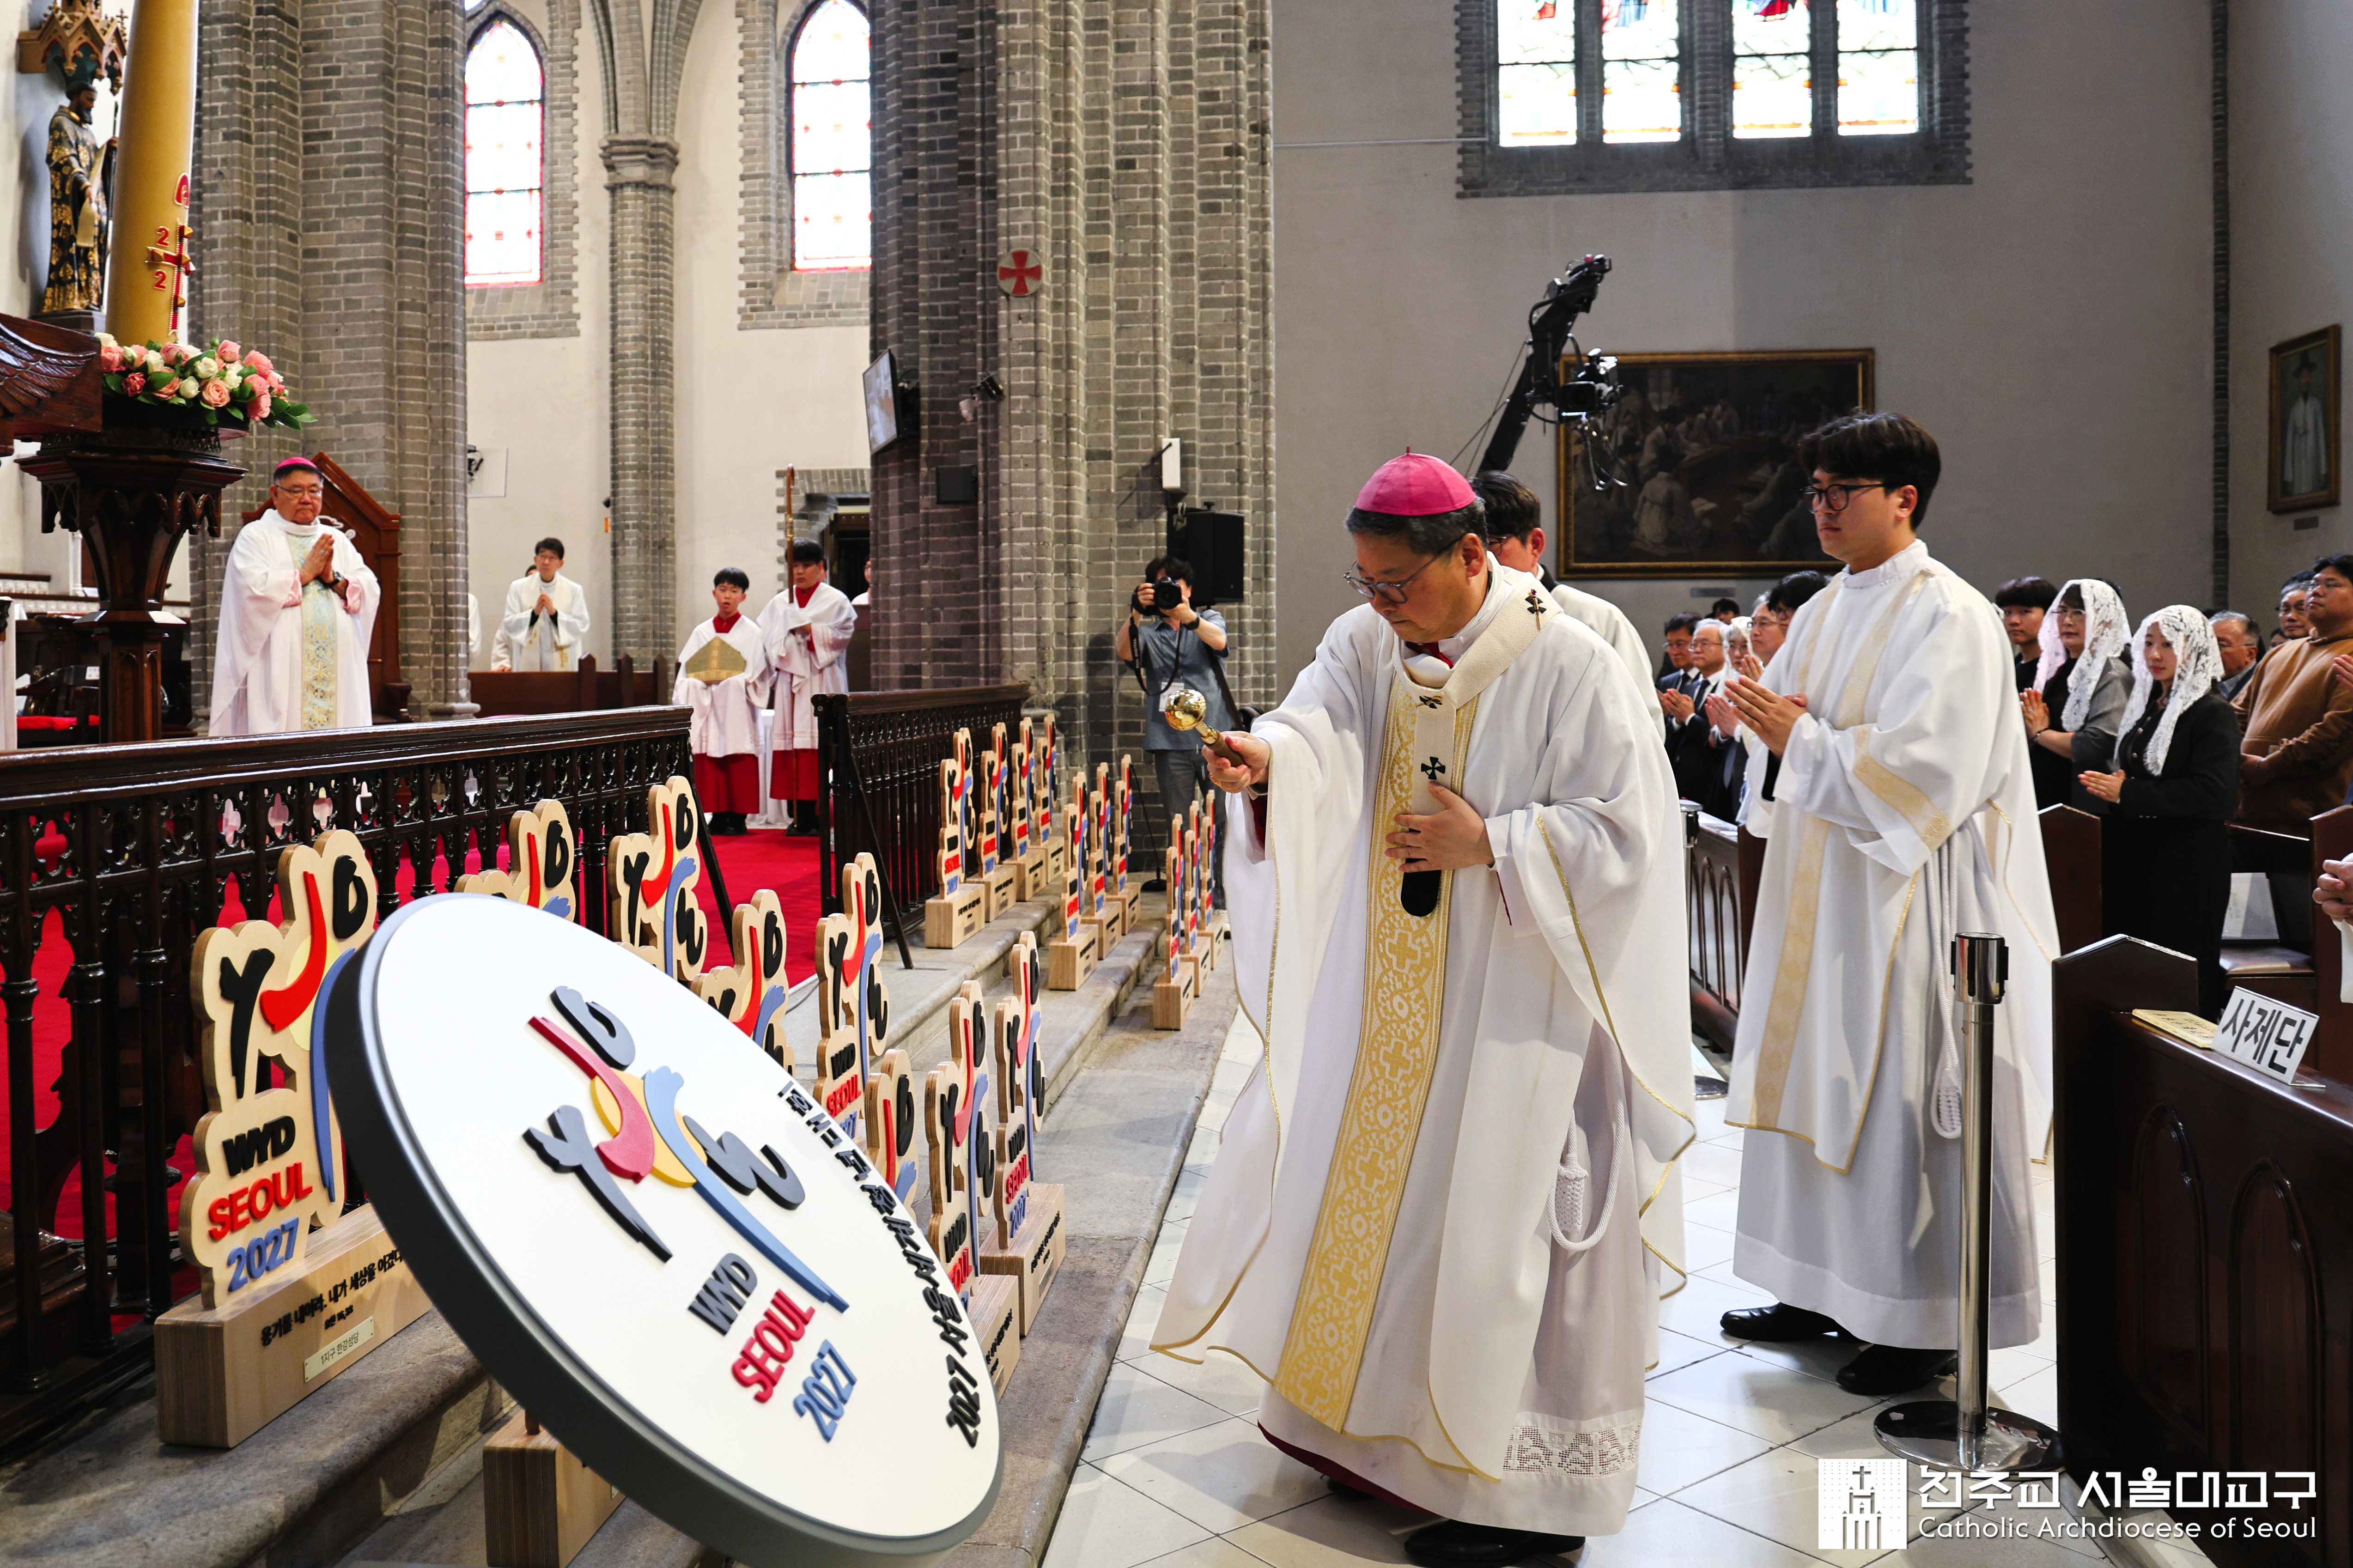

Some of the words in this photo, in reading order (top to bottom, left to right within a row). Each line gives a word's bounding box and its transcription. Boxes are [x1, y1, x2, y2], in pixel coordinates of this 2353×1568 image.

[831, 1043, 856, 1080] WYD
[2221, 999, 2303, 1075] 사제단
[827, 1074, 862, 1118] SEOUL
[222, 1115, 296, 1176] WYD
[839, 1111, 857, 1139] 27
[208, 1161, 313, 1240] SEOUL
[1006, 1154, 1030, 1204] SEOUL
[944, 1212, 967, 1263] WYD
[1010, 1191, 1026, 1238] 2027
[227, 1216, 299, 1292] 2027
[948, 1247, 973, 1294] OUL
[328, 1279, 348, 1302] 내가
[349, 1263, 376, 1290] 세상을
[687, 1253, 757, 1337] WYD
[320, 1349, 335, 1365] 1지구
[336, 1331, 359, 1355] 한강성당
[731, 1288, 815, 1404] SEOUL
[793, 1339, 857, 1443] 2027
[946, 1354, 980, 1448] 2027
